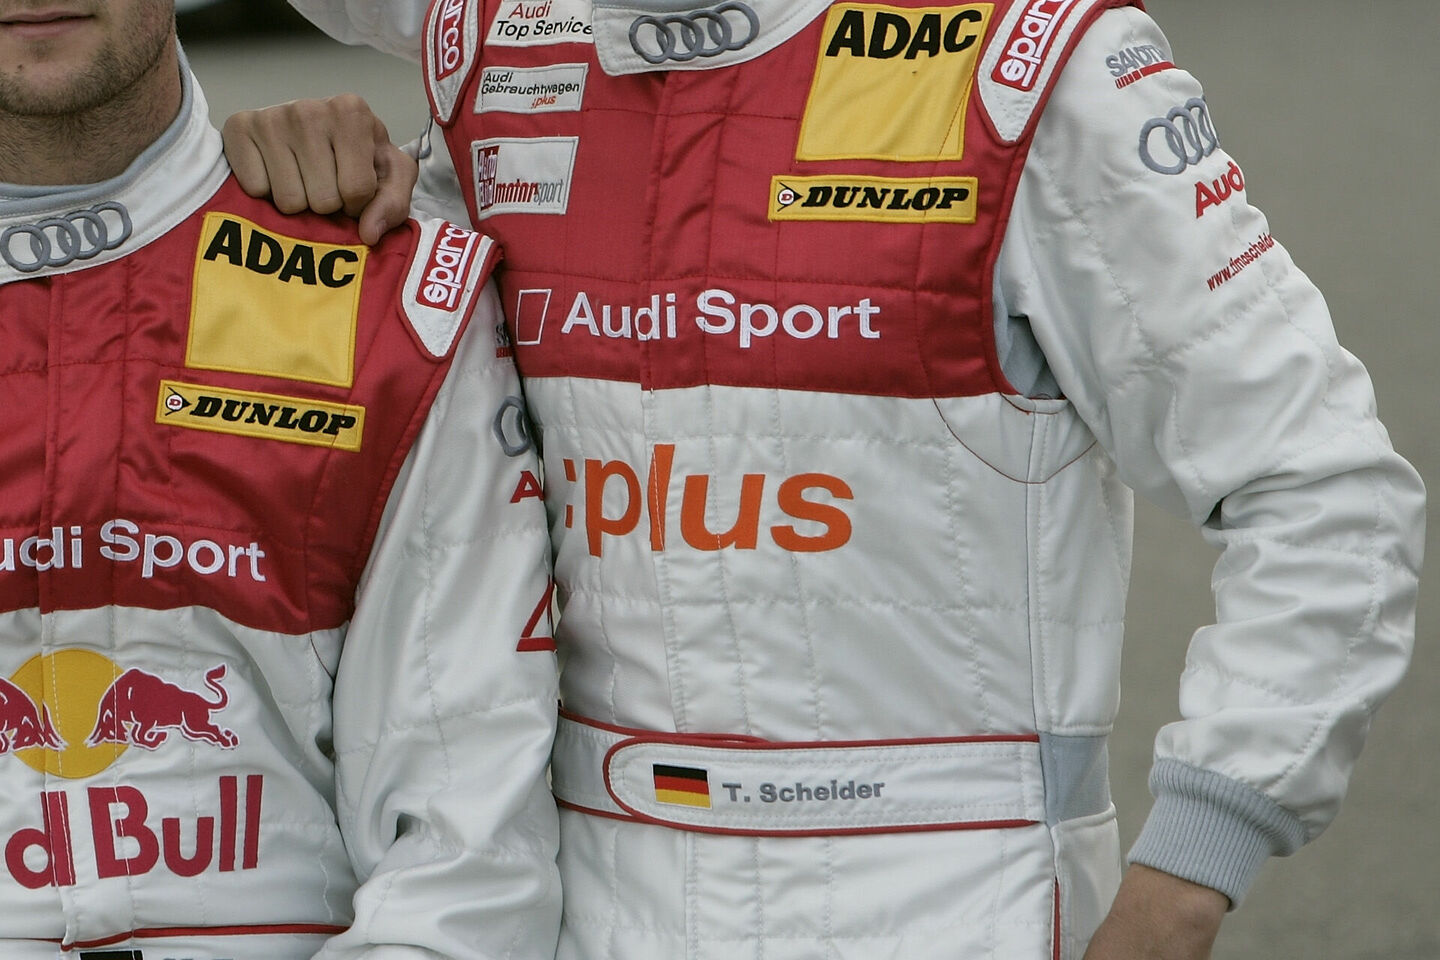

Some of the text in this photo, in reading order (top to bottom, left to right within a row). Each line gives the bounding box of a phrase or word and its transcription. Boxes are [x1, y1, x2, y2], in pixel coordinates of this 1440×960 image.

[497, 17, 592, 40] Top Service
[508, 0, 552, 19] Audi
[826, 9, 983, 60] ADAC
[482, 83, 580, 97] Gebrauchtwagen
[483, 72, 513, 83] Audi
[801, 185, 970, 211] DUNLOP
[1195, 161, 1244, 219] Aud
[203, 219, 358, 289] ADAC
[423, 223, 473, 304] sparc
[561, 291, 677, 341] Audi
[696, 289, 881, 349] Sport
[190, 396, 356, 436] DUNLOP
[99, 519, 266, 581] Sport
[722, 779, 886, 803] T. Scheider
[87, 774, 264, 879] Bull
